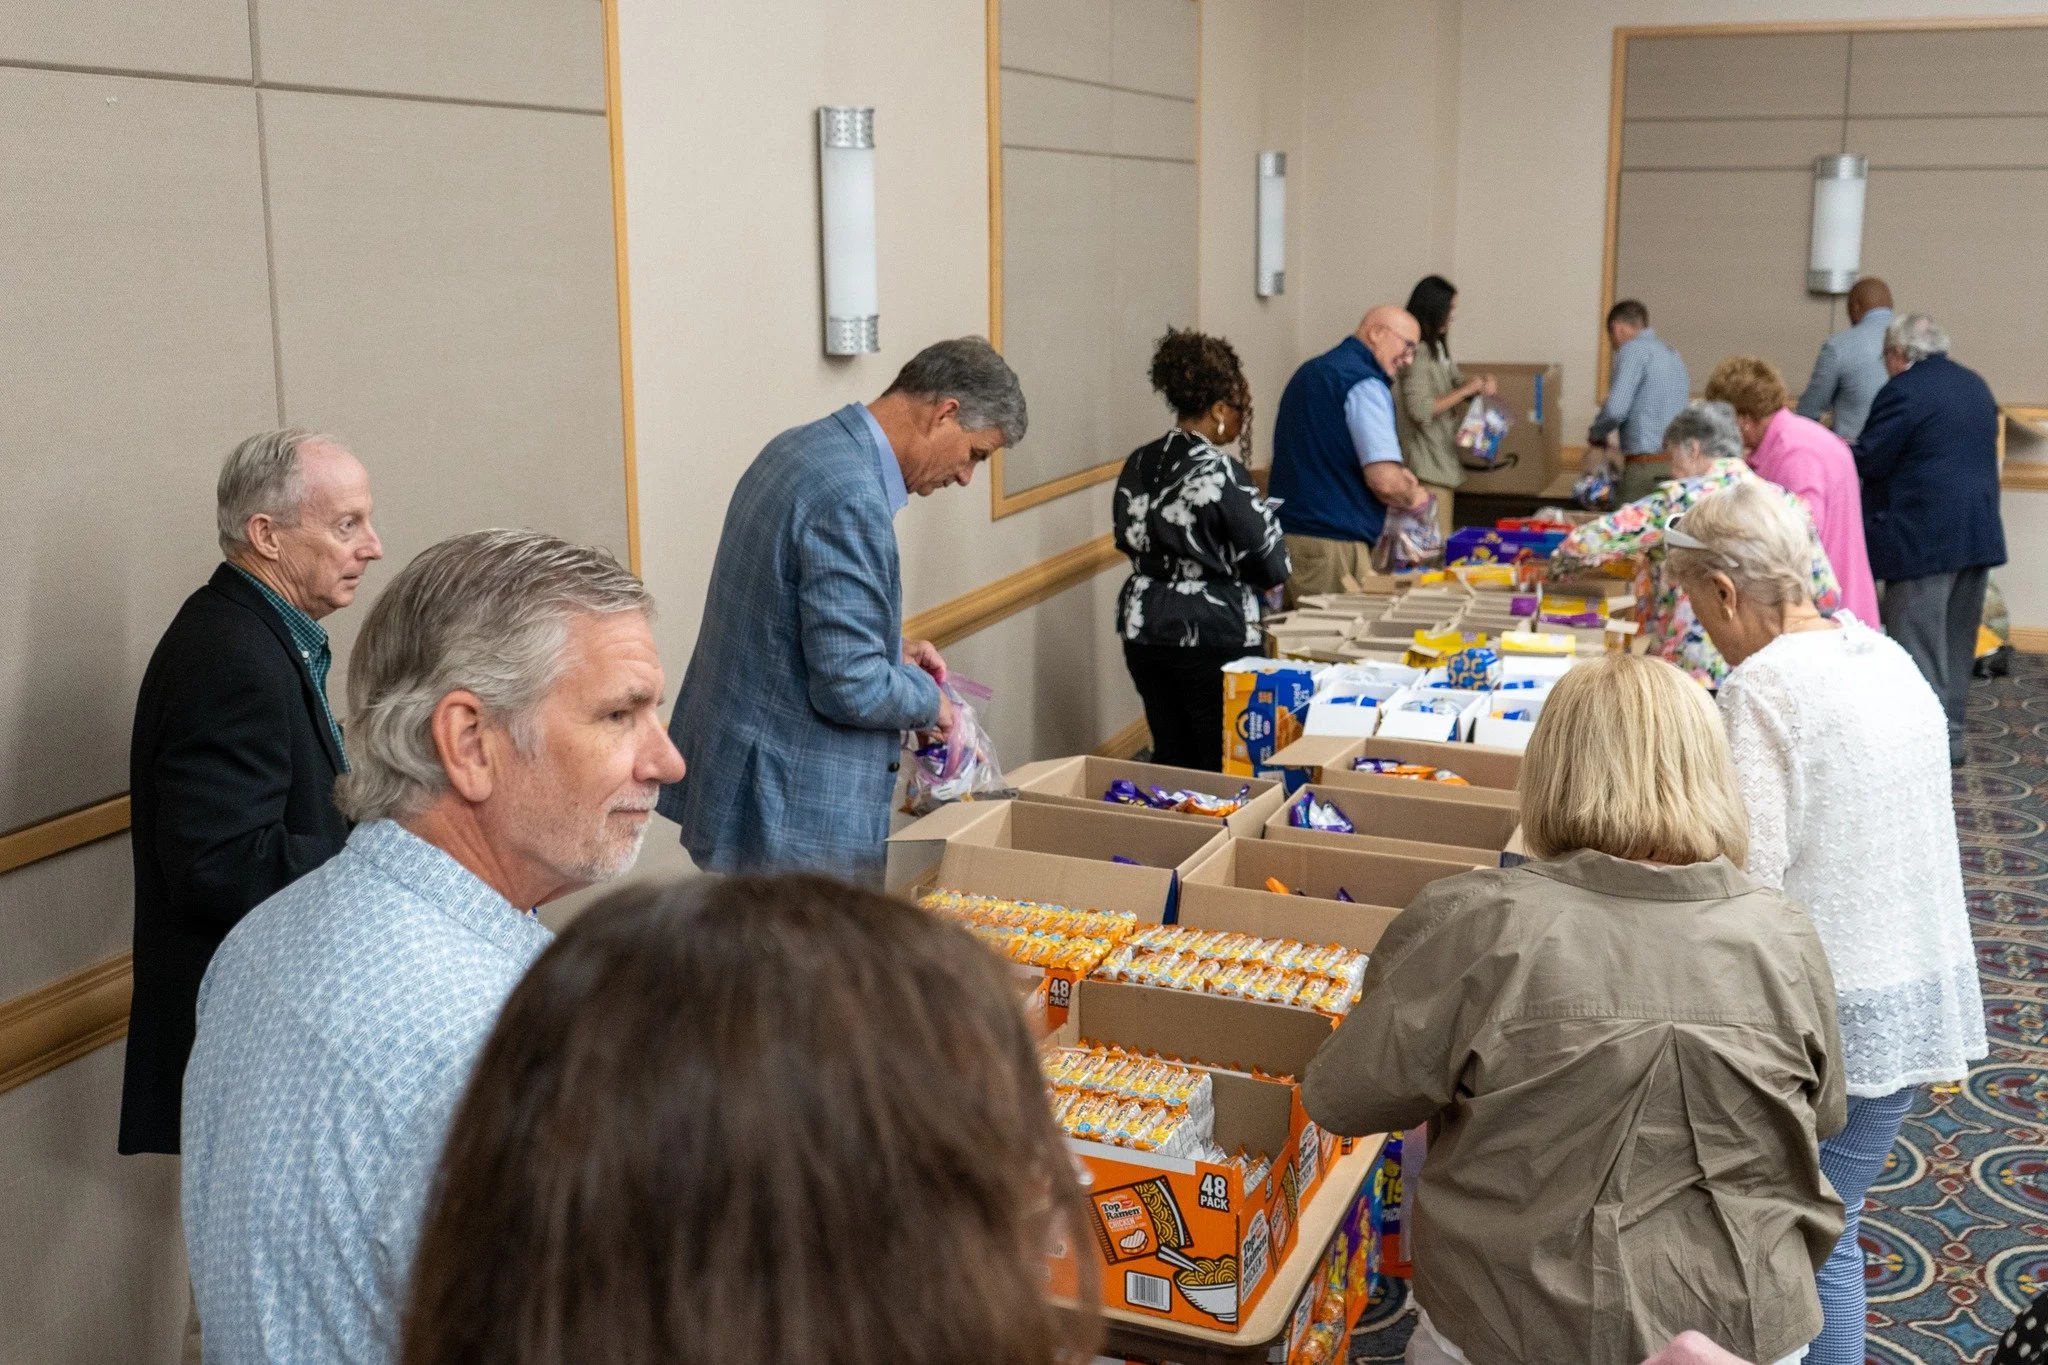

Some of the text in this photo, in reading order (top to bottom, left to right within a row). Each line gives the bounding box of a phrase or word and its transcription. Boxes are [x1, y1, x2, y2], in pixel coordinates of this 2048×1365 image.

[1050, 979, 1069, 998] 48
[1201, 1174, 1227, 1198] 48
[1102, 1202, 1120, 1213] Top
[1200, 1195, 1229, 1211] PACK
[1105, 1207, 1141, 1220] Ramen
